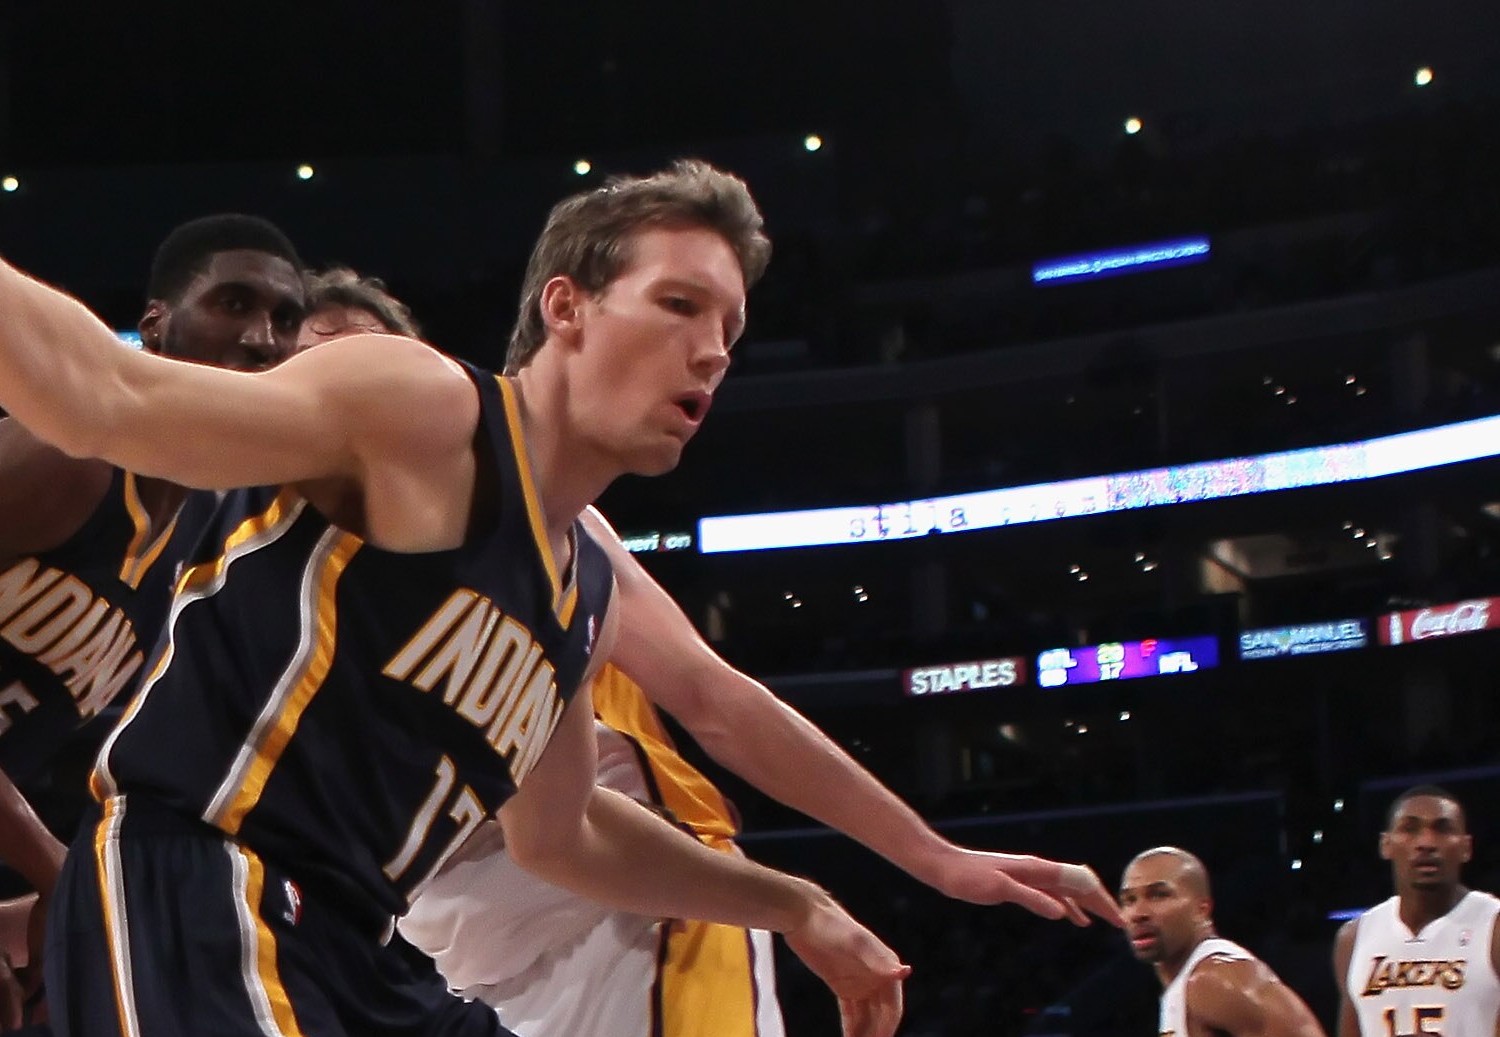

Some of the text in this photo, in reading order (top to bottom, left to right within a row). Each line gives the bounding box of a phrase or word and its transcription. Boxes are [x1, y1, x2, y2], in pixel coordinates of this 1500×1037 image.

[381, 588, 565, 788] INDIAN
[910, 662, 1017, 695] STAPLES
[382, 754, 487, 903] 17
[1362, 956, 1466, 997] LAKERS
